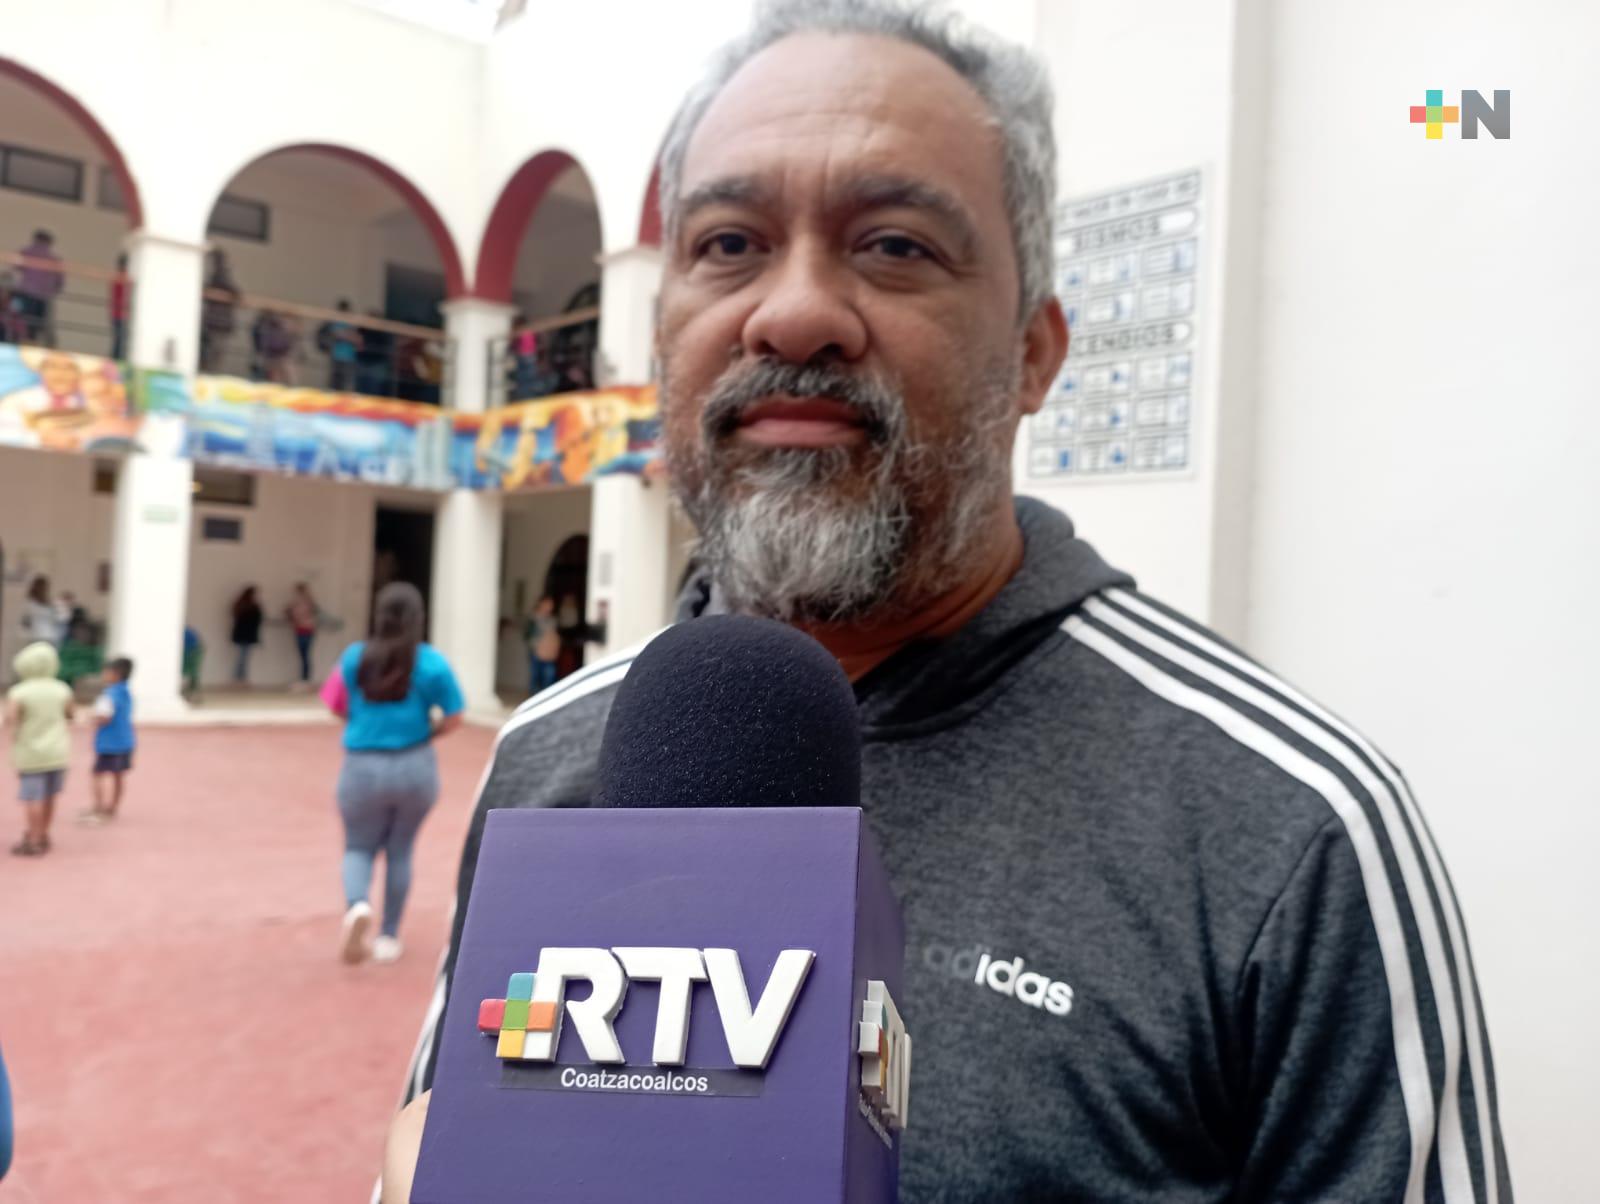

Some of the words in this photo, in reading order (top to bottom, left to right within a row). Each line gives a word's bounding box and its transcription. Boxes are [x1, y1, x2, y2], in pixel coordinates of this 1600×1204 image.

[1069, 321, 1175, 358] CENDIOS
[924, 943, 1074, 1016] adidas
[560, 1067, 709, 1092] Coatzacoalcos
